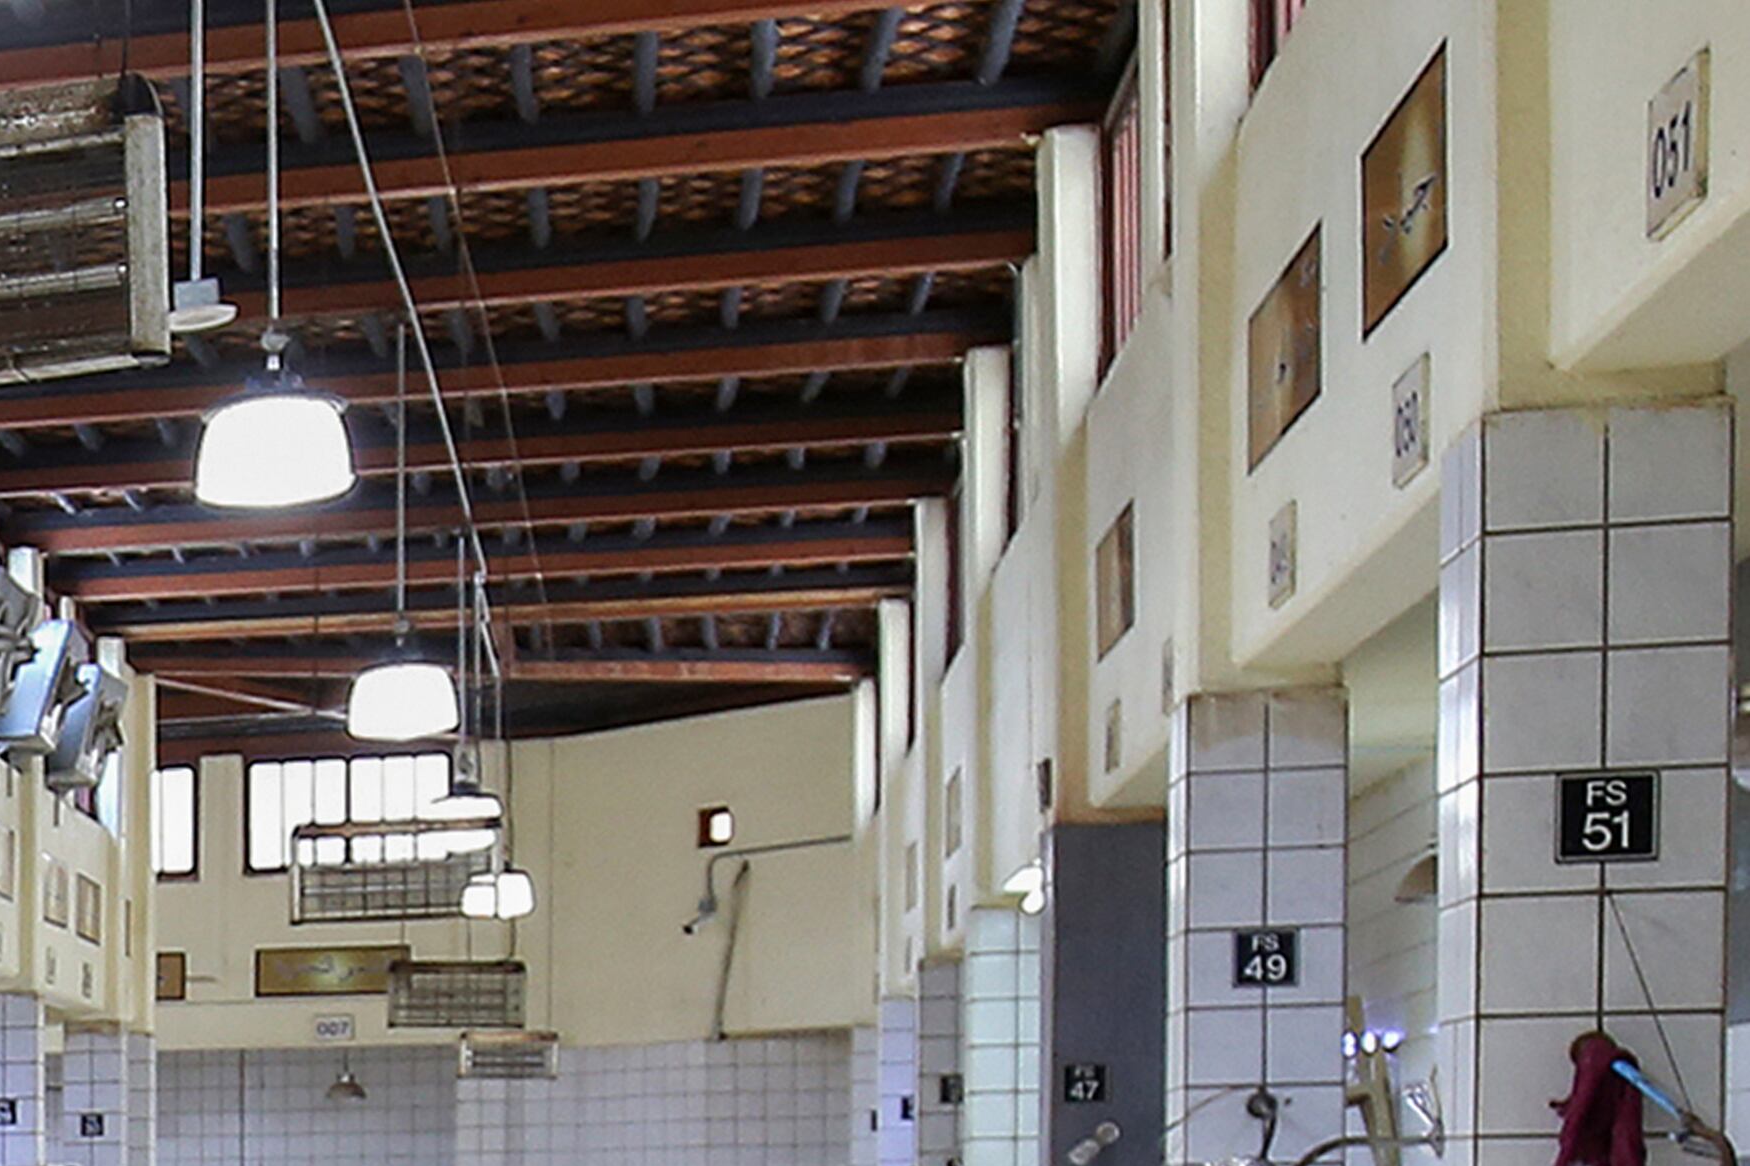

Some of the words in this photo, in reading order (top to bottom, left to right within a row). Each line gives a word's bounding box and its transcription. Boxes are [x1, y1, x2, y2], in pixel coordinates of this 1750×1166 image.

[1653, 100, 1691, 198] 051
[1585, 779, 1627, 807] FS
[1581, 809, 1630, 851] 51
[1251, 933, 1280, 951] FS
[1243, 953, 1287, 980] 49
[1070, 1080, 1099, 1099] 47
